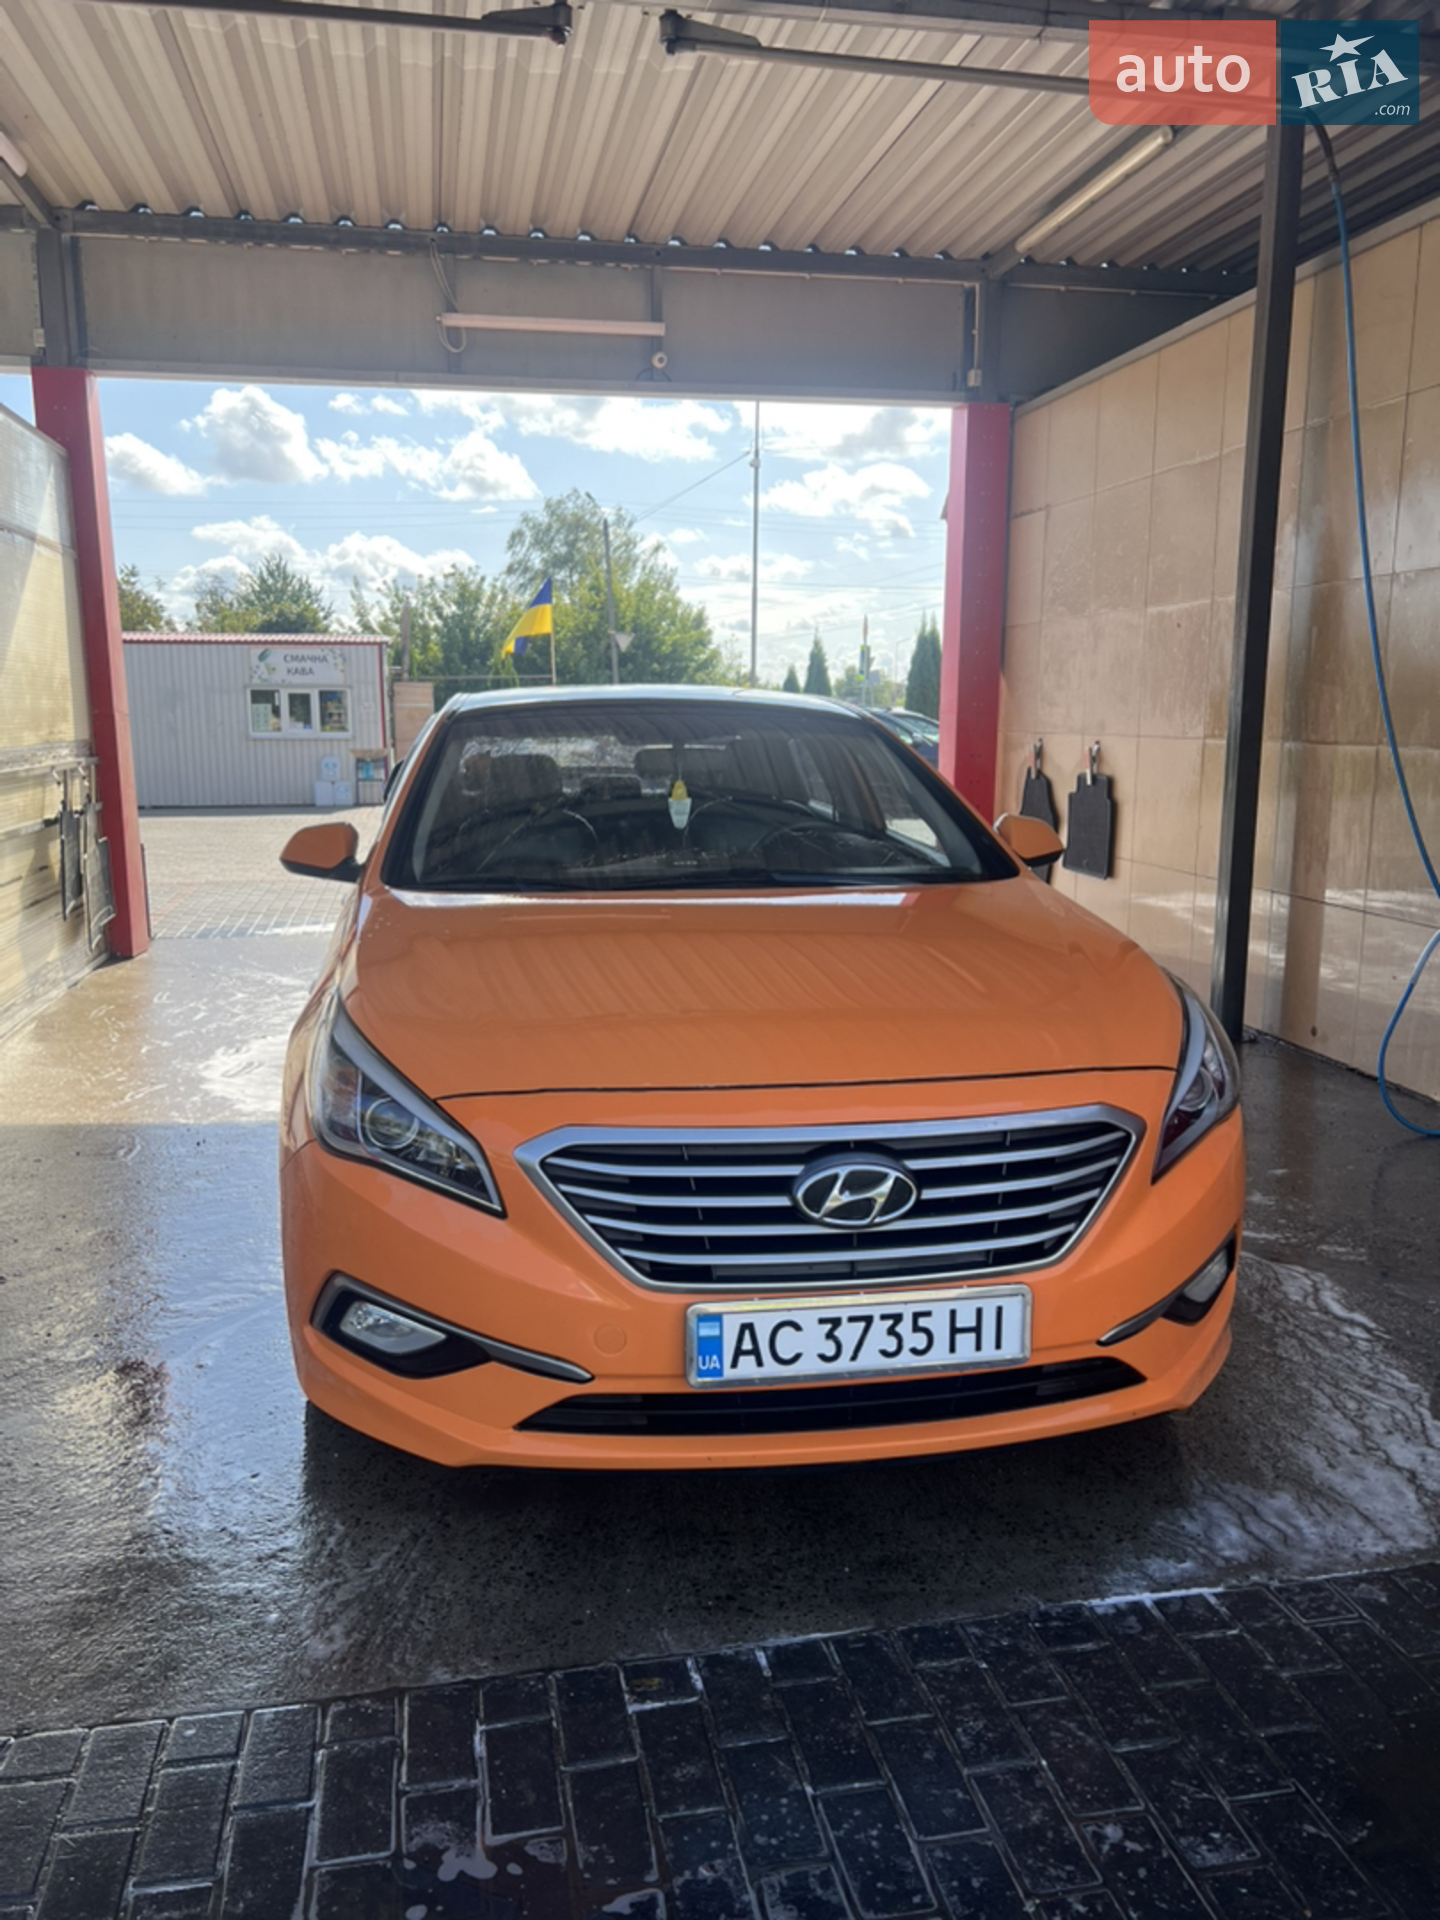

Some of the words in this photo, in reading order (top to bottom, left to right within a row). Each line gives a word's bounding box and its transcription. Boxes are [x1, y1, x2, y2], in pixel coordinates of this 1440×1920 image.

[283, 653, 329, 664] СМАЧНА
[286, 666, 315, 676] КАВА
[816, 1310, 935, 1363] 3735
[698, 1354, 721, 1370] UA
